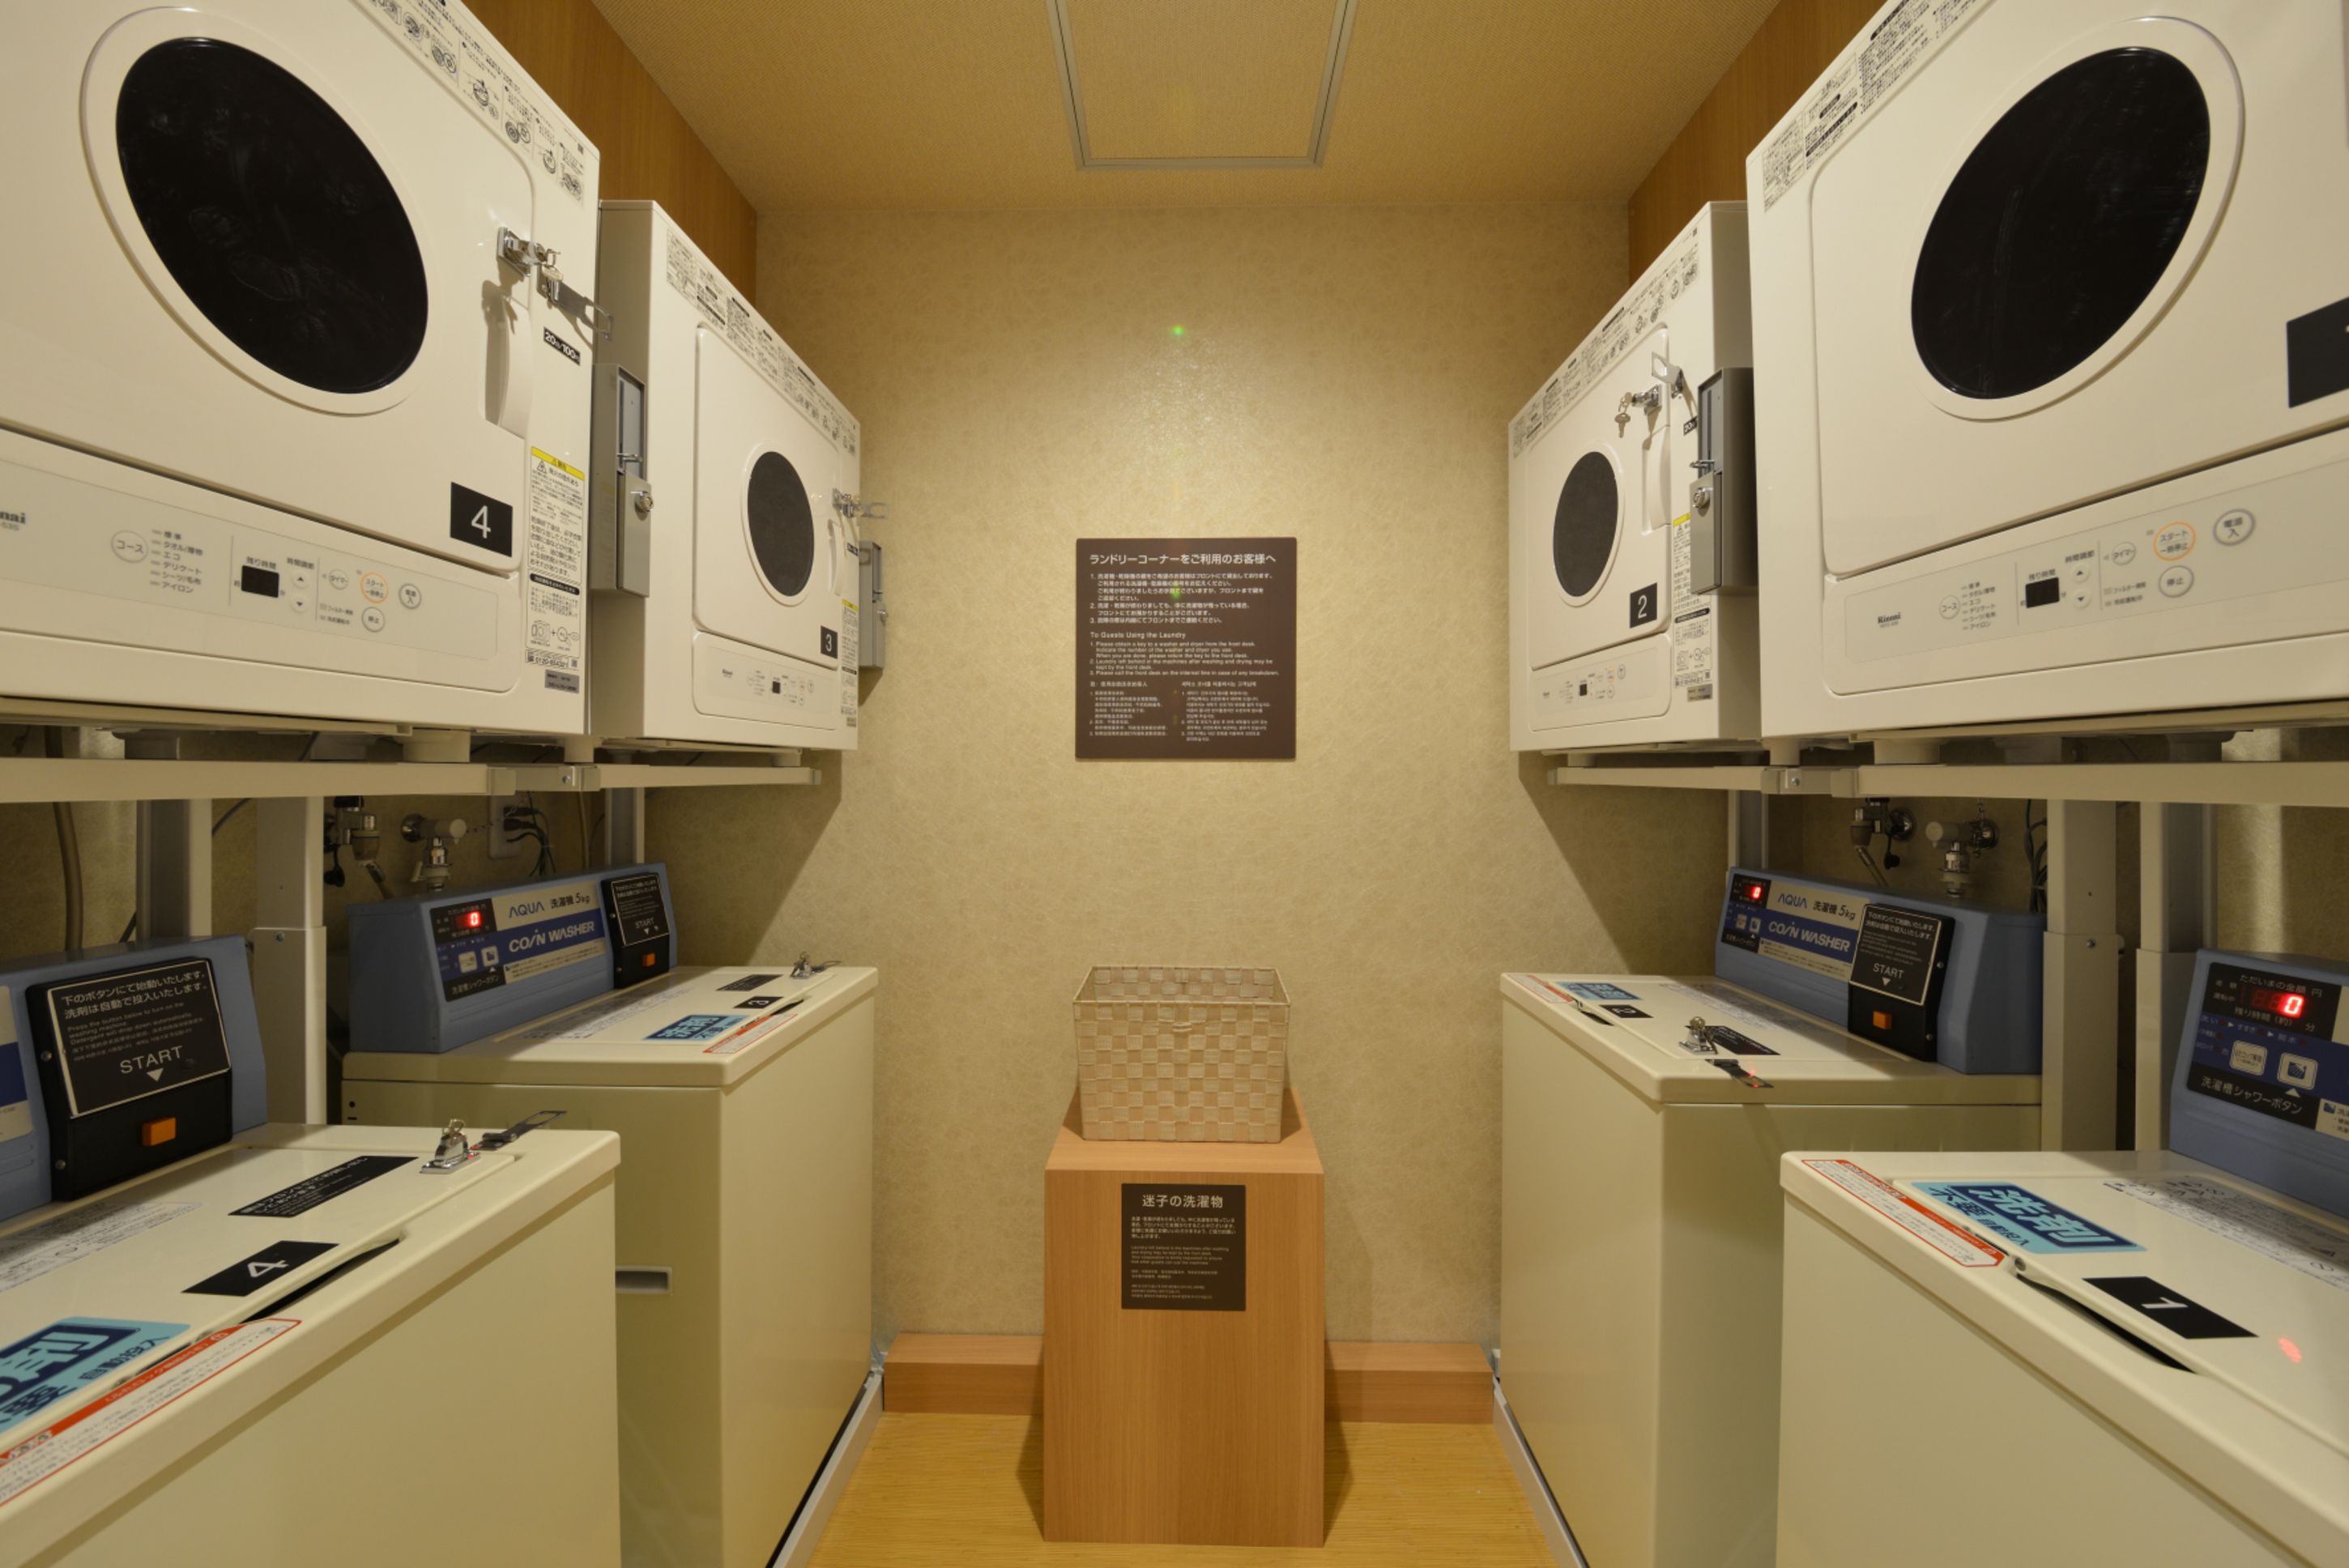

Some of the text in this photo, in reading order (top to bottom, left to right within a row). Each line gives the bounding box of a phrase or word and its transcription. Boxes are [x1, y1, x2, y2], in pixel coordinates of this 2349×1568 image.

[0, 511, 26, 525] nai
[471, 505, 491, 539] 4
[2160, 530, 2188, 543] スタート
[2228, 528, 2239, 538] 入
[117, 540, 143, 553] コース
[163, 552, 181, 560] エコ
[1089, 554, 1277, 565] ランドリーコーナーをご利用のお客様へ
[163, 562, 202, 575] デリケート
[162, 582, 194, 594] アイロン
[365, 579, 384, 587] スタート
[2167, 577, 2184, 586] 停止
[1638, 595, 1648, 619] 2
[1942, 603, 1957, 613] コース
[825, 634, 832, 652] 3
[509, 893, 590, 918] AQUA 洗濯機 5kg
[1778, 893, 1856, 921] AQUA 洗濯機 5kg
[471, 911, 480, 925] 0
[634, 918, 654, 929] START
[509, 921, 595, 952] COIN WASHER
[1768, 921, 1798, 938] COIN
[1801, 927, 1852, 952] WASHER
[1873, 963, 1904, 978] START
[62, 970, 206, 1005] 下のボタンにて始動いたします。
[2240, 974, 2307, 995] ただいまの金額
[2285, 996, 2303, 1015] 0
[119, 1046, 183, 1073] START
[2201, 1075, 2302, 1114] 洗濯槽シャワーボタン
[1142, 1195, 1223, 1208] 迷子の洗濯物
[1929, 1187, 1996, 1216] 不要
[1968, 1188, 2116, 1243] 洗剤
[246, 1259, 289, 1278] 4
[2140, 1297, 2188, 1310] 1
[77, 1336, 170, 1380] 自動投入
